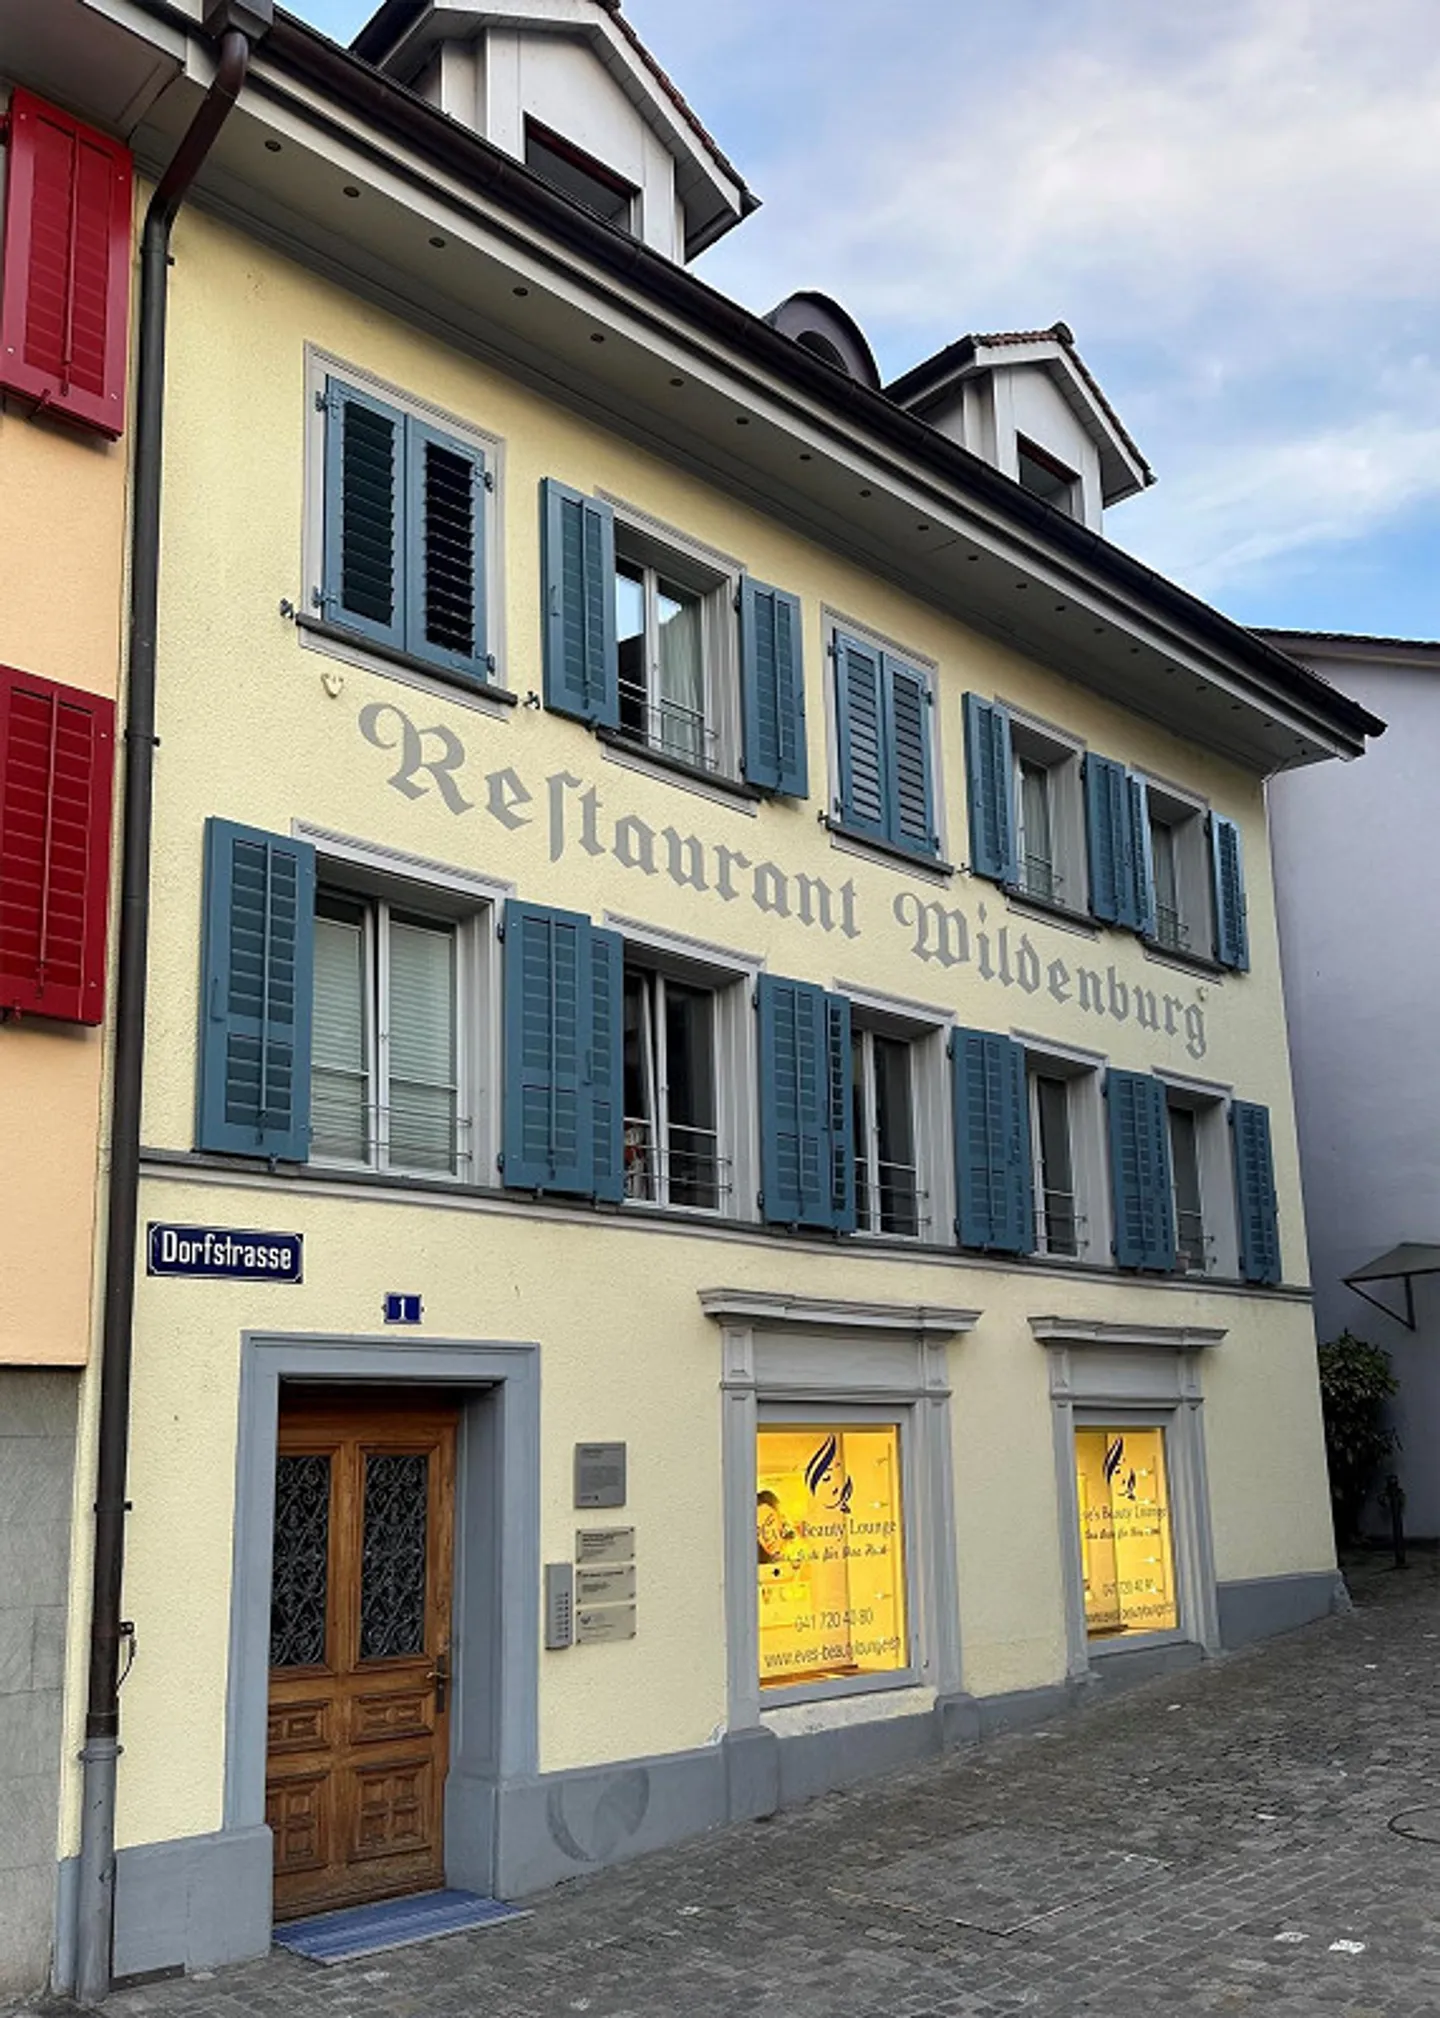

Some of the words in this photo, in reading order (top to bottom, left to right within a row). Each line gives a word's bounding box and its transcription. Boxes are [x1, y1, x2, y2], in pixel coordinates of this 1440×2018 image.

[892, 892, 1208, 1061] Wildenburg
[162, 1231, 292, 1270] Dorfstrasse
[802, 1520, 846, 1542] Beauty
[850, 1518, 897, 1538] Lounge
[795, 1613, 816, 1633] 041
[820, 1610, 842, 1630] 720
